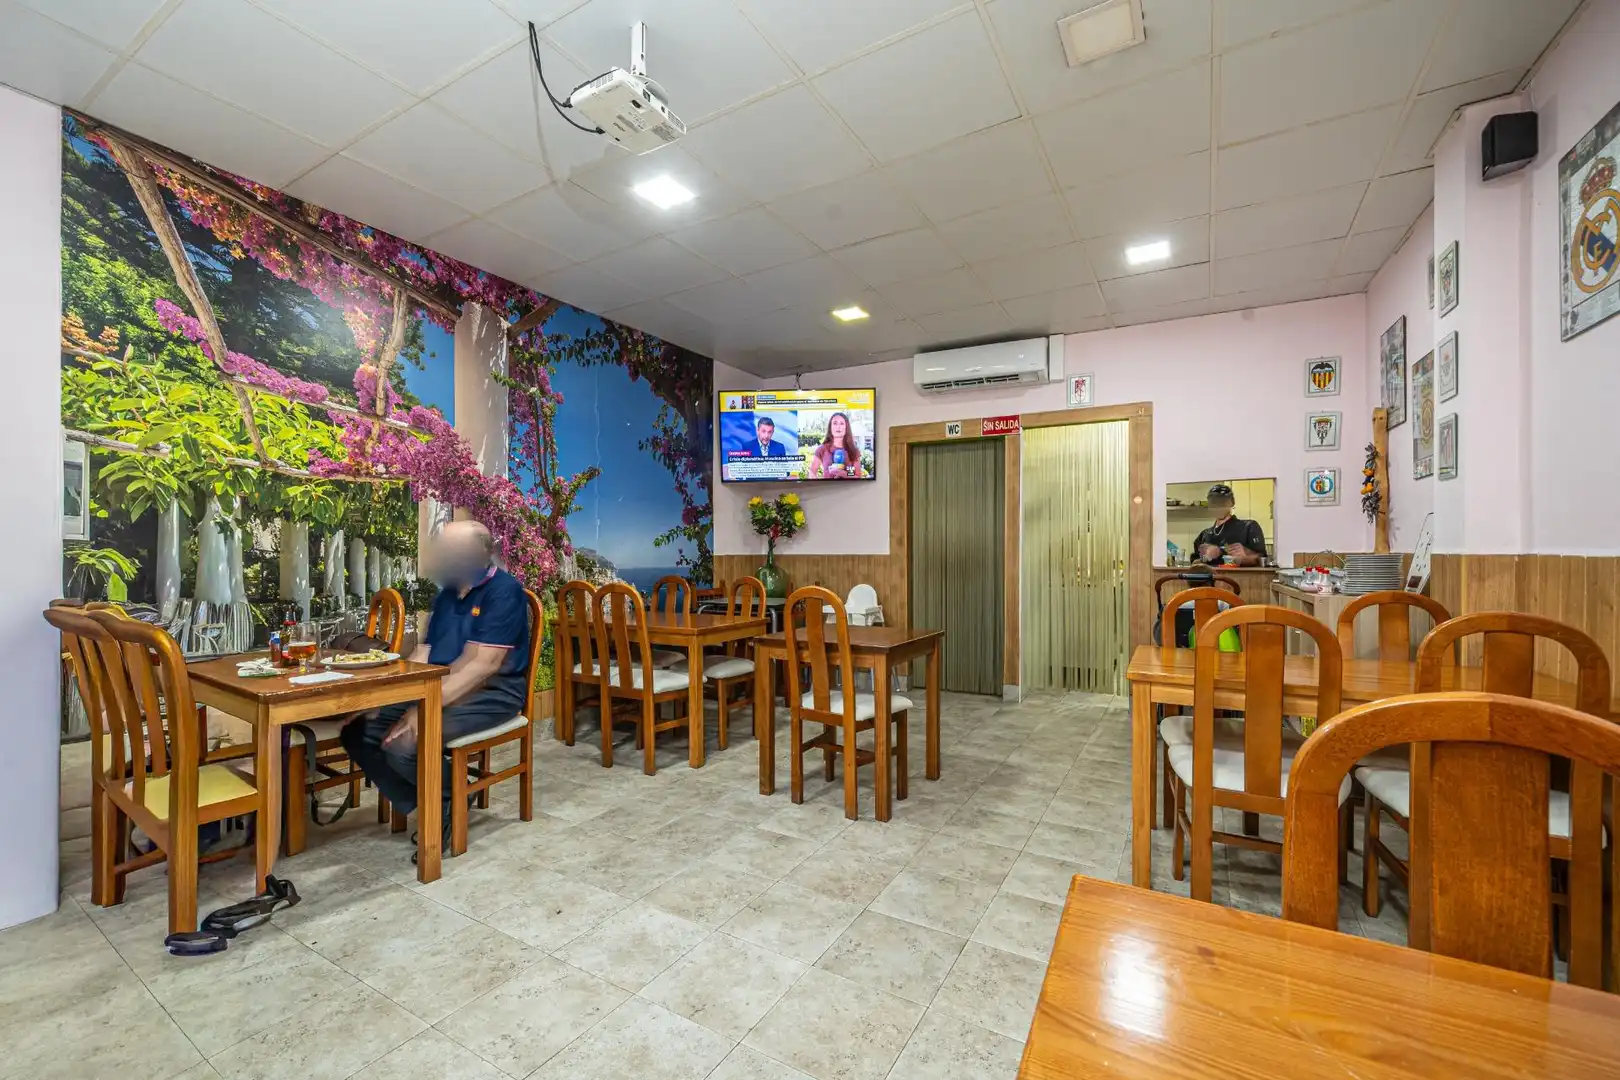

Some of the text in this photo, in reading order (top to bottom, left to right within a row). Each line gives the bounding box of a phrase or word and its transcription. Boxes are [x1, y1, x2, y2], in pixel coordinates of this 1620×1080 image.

[947, 424, 960, 435] WC
[983, 419, 1019, 431] SIN SALIDA
